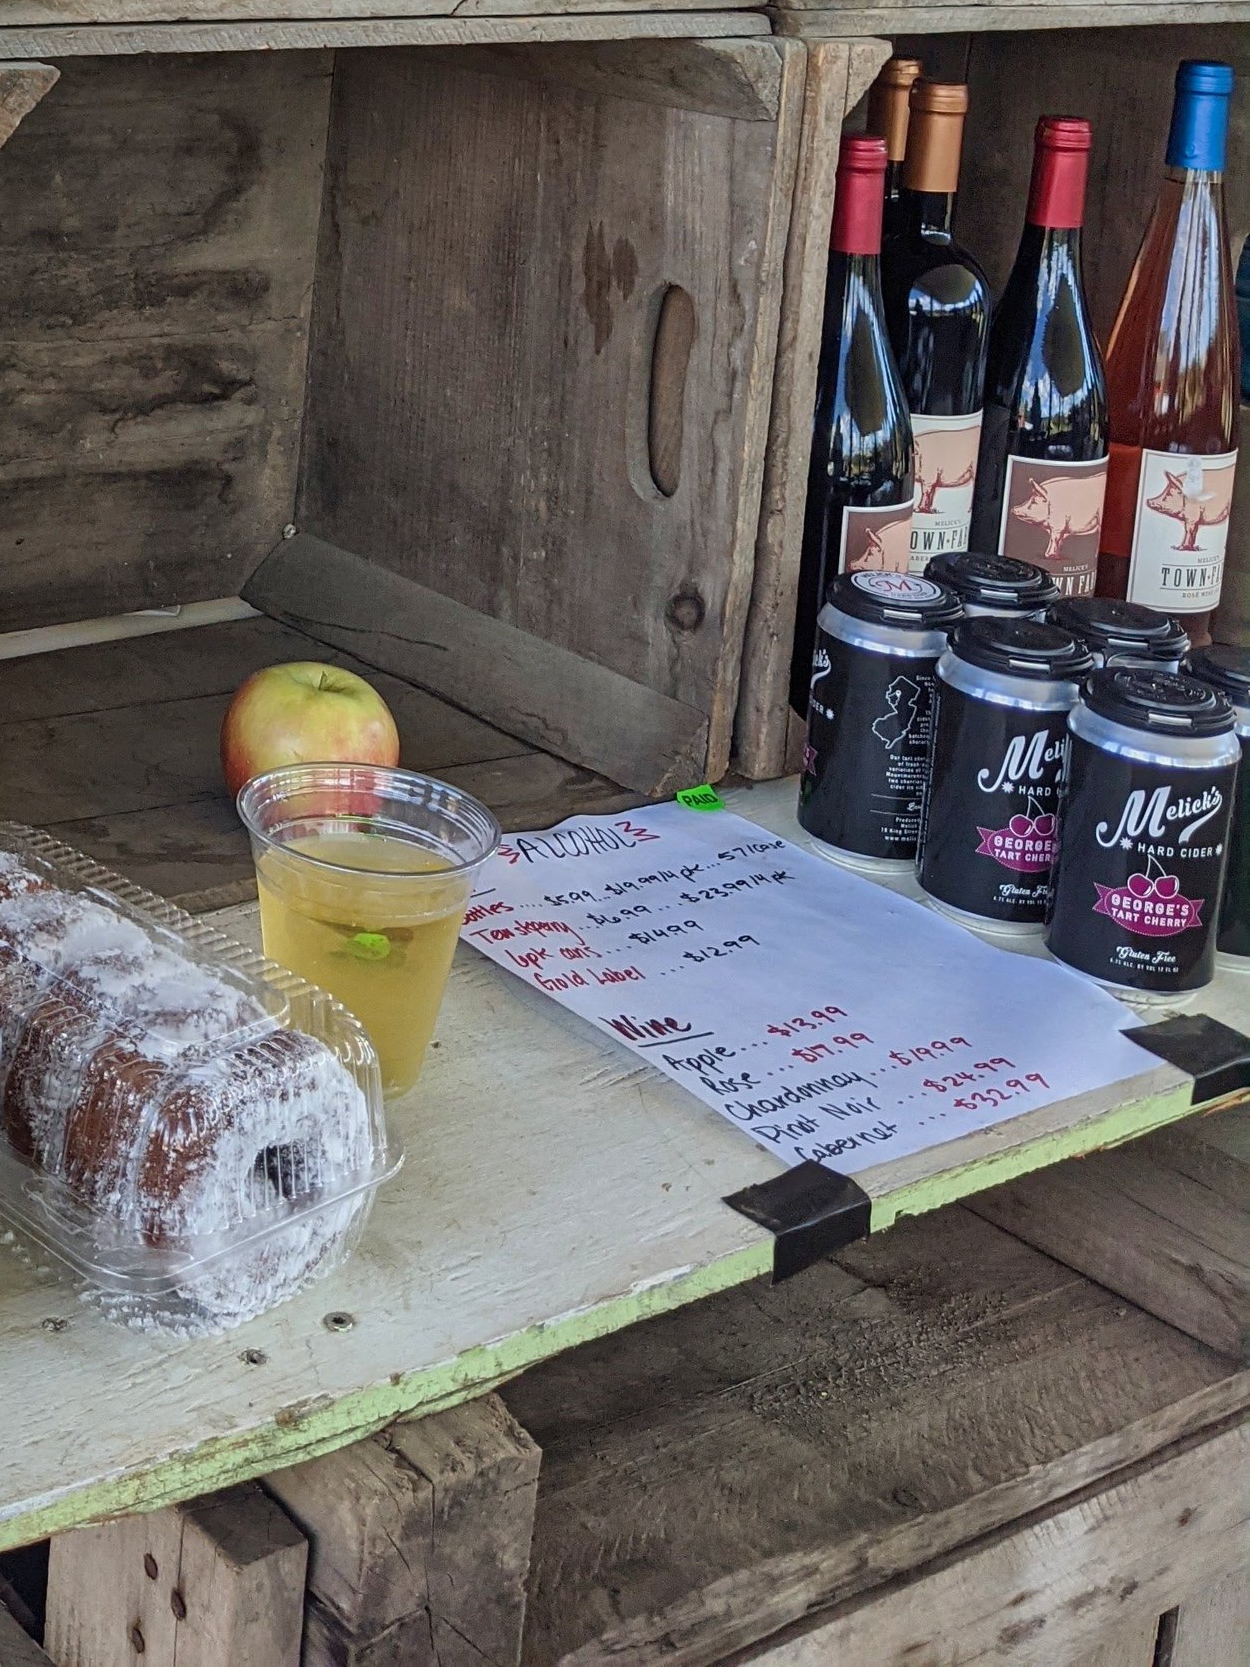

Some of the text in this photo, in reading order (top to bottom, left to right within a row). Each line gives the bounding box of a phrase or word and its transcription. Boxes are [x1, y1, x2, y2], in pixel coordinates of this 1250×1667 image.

[910, 531, 946, 551] OWN
[1052, 576, 1074, 596] WN
[1161, 567, 1207, 587] TOWN
[683, 793, 720, 807] PAID
[1019, 785, 1051, 797] HARD
[1095, 785, 1223, 848] Melick's
[517, 824, 637, 864] ALCOHOL
[994, 848, 1020, 861] TART
[1137, 842, 1213, 858] HARD CIDER
[999, 884, 1031, 896] Gluten
[587, 904, 652, 928] $6.99
[1111, 893, 1190, 916] GEORGE'S
[1111, 907, 1187, 928] TART CHERRY
[560, 945, 603, 962] cans
[628, 919, 704, 945] $14.99
[534, 934, 761, 993] Gold Label $12.99
[1116, 945, 1177, 964] Gluten Free
[598, 1013, 693, 1043] Wine
[661, 1004, 849, 1077] Apple $13.99
[702, 1031, 875, 1097] Rose $17.99
[723, 1035, 973, 1122] Chardonnay $19.99
[751, 1056, 1017, 1145] Pinot Noir $24.99
[794, 1071, 1050, 1164] Cabernet $32.99
